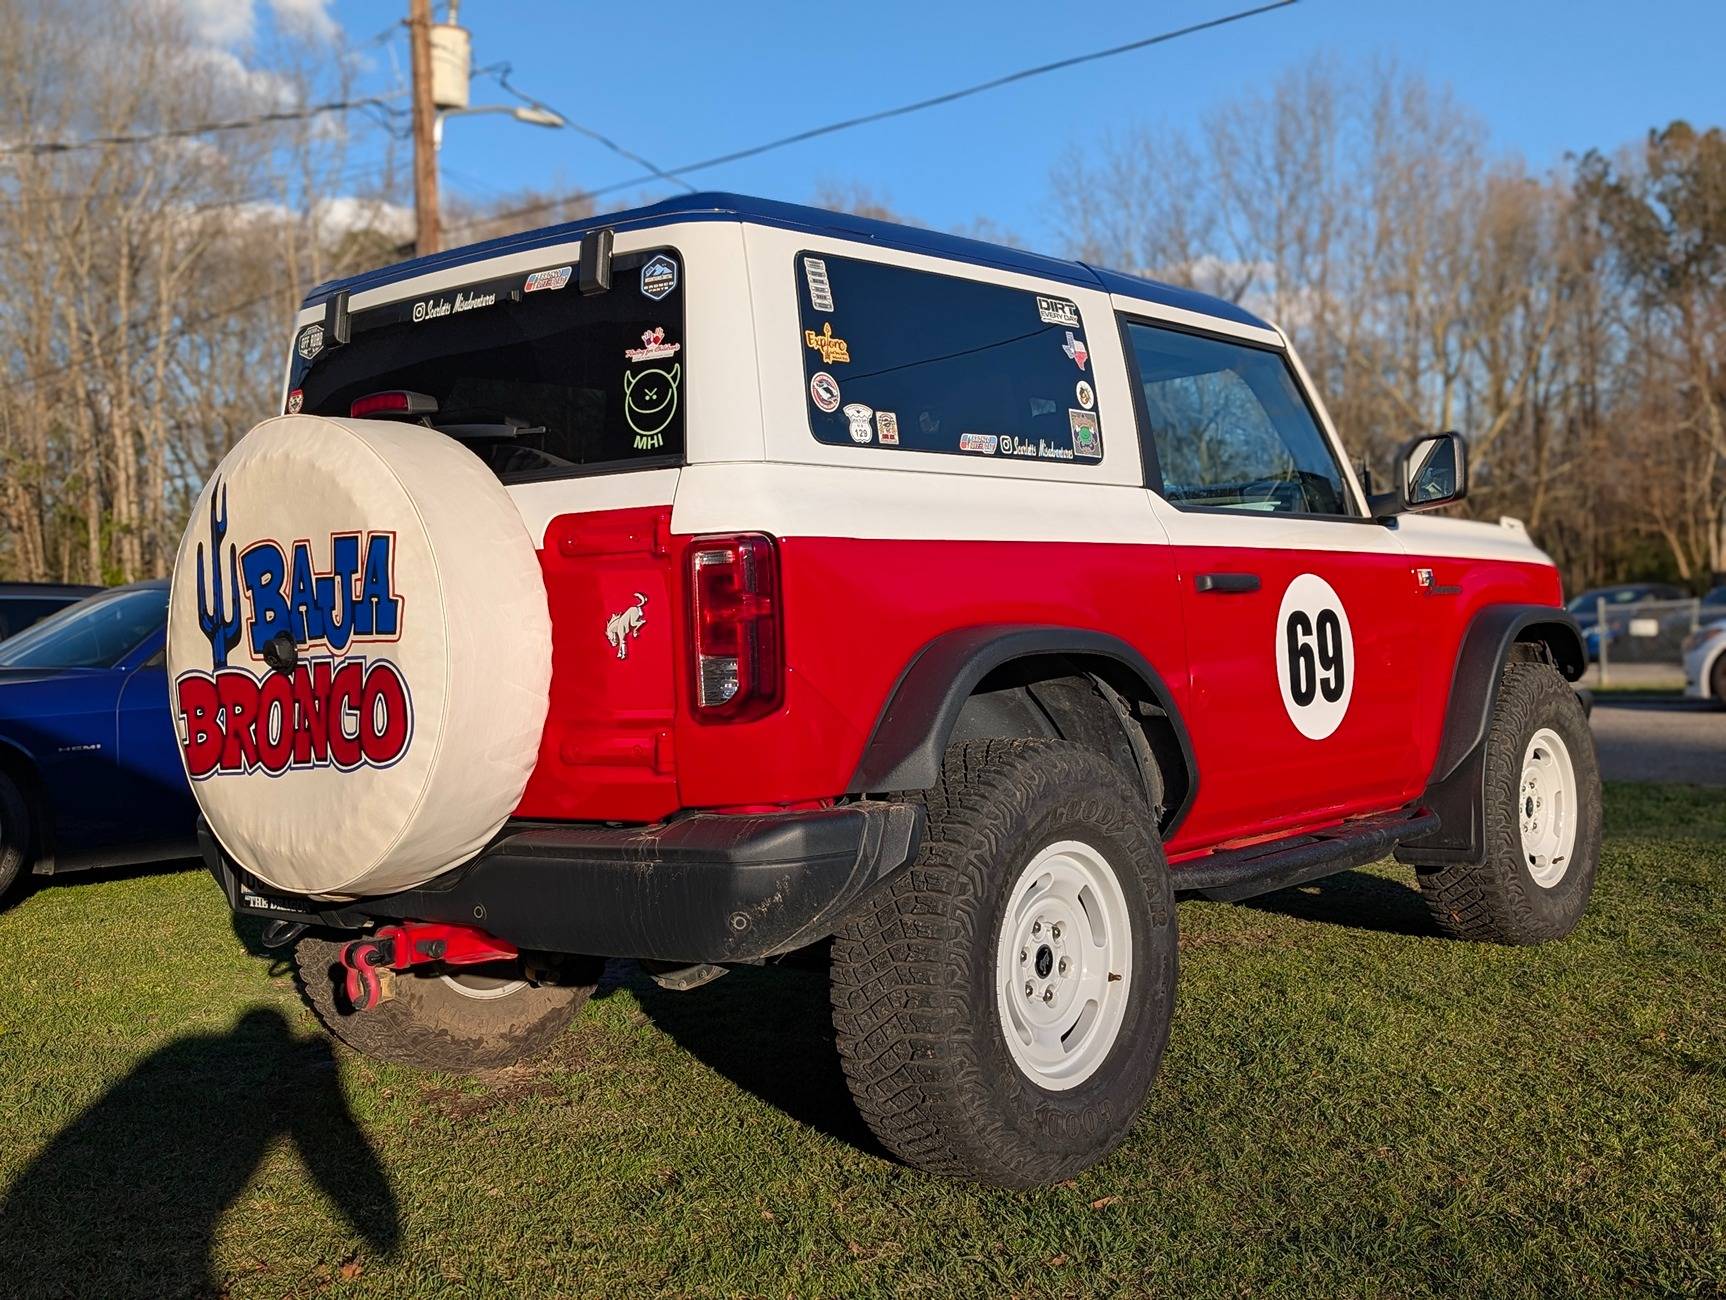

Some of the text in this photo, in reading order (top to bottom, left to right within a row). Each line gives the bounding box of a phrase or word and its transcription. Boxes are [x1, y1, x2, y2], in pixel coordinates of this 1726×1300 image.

[1038, 298, 1076, 316] DIRT
[1040, 310, 1063, 320] EVERY
[633, 433, 664, 450] MHI
[241, 530, 404, 661] BAJA
[1286, 608, 1345, 707] 69
[176, 655, 414, 781] BRONCO
